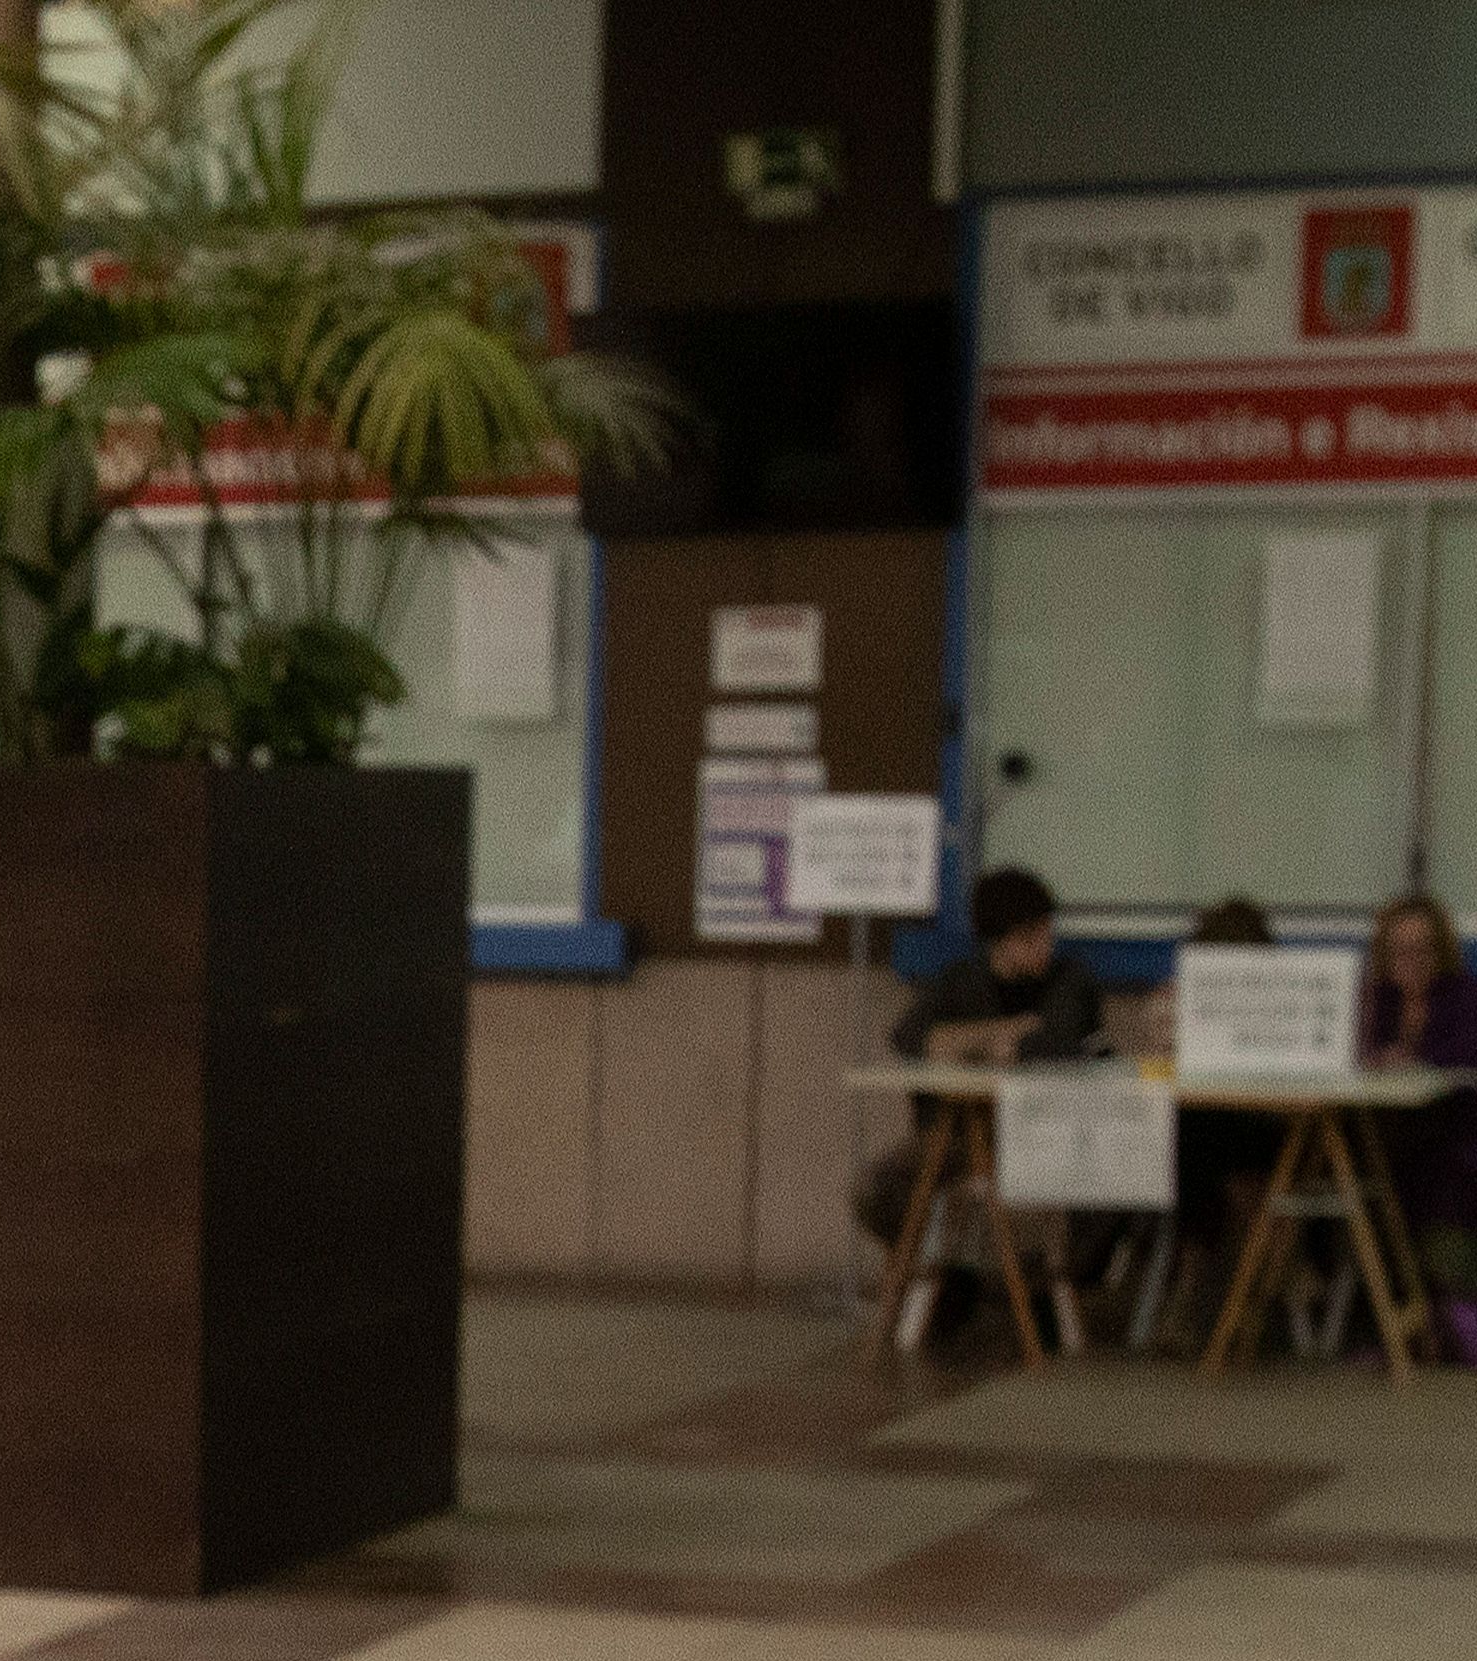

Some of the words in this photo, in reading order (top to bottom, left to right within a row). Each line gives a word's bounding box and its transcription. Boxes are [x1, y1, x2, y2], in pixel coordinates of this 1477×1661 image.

[1021, 231, 1264, 277] CONCELLO
[1052, 282, 1104, 323] DE
[1125, 278, 1236, 320] VIGO
